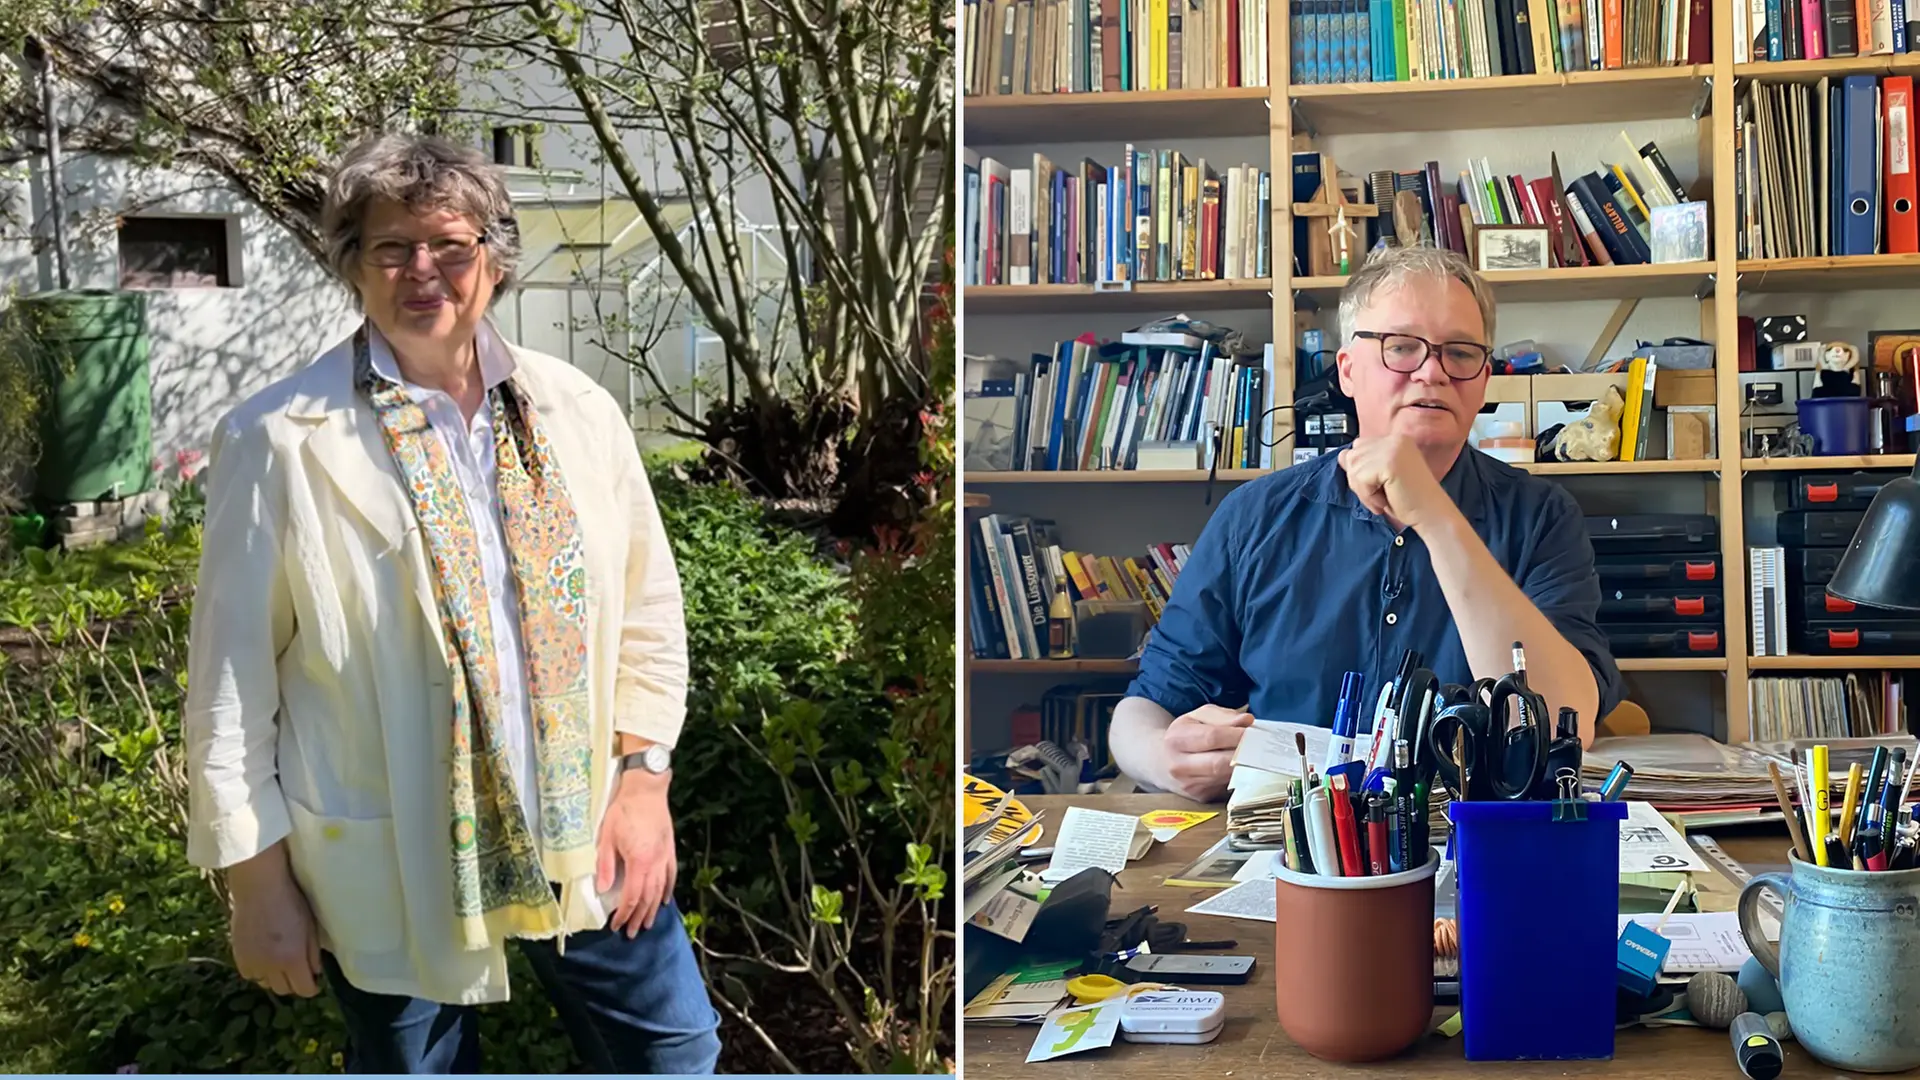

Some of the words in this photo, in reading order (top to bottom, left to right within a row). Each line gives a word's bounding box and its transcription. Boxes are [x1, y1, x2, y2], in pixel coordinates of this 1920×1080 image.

[1602, 202, 1628, 235] KOLLAPS
[1022, 555, 1040, 604] Lüssower
[1033, 604, 1046, 626] Die
[1398, 797, 1406, 829] STIFTUNG
[1624, 939, 1658, 960] WEMAG
